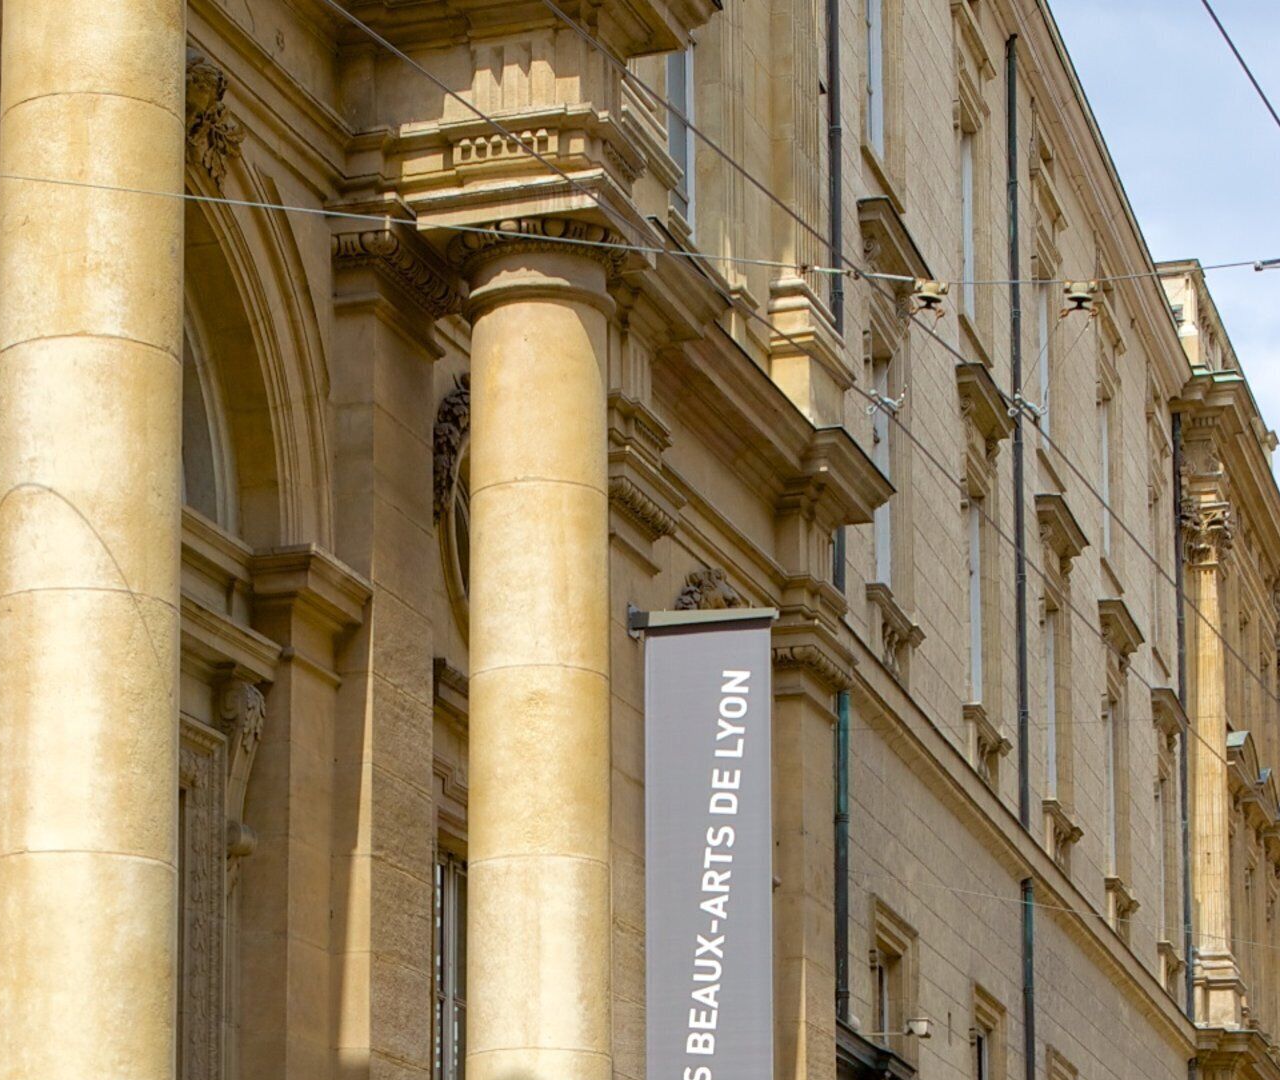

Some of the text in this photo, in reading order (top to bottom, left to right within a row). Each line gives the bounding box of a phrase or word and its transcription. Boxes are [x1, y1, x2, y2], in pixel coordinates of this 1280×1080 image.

[713, 668, 751, 759] LYON
[708, 769, 742, 816] DE
[685, 825, 736, 1057] BEAUX-ARTS
